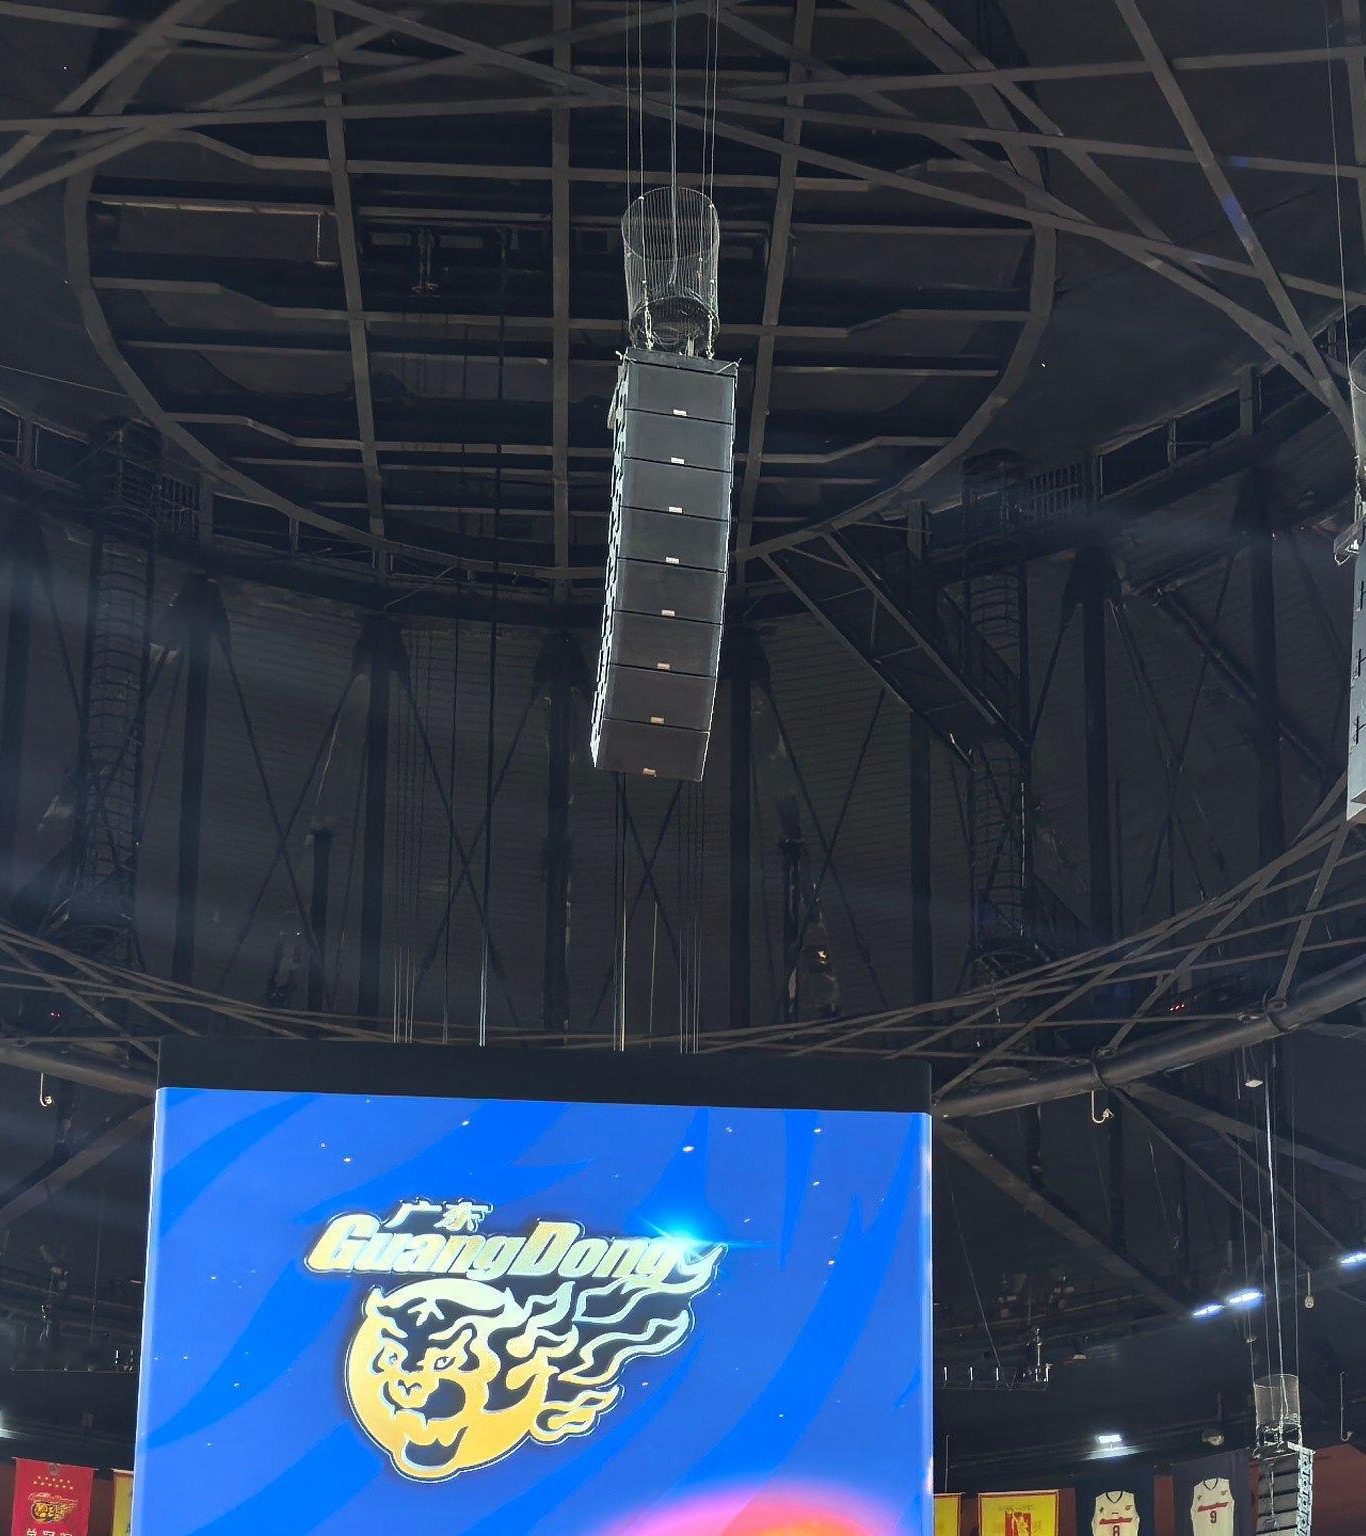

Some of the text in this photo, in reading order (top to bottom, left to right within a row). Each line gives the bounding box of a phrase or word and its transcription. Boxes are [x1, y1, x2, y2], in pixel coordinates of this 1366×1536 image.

[383, 1199, 493, 1232] 广东
[306, 1212, 727, 1289] GuangDong
[1209, 1509, 1217, 1524] 9
